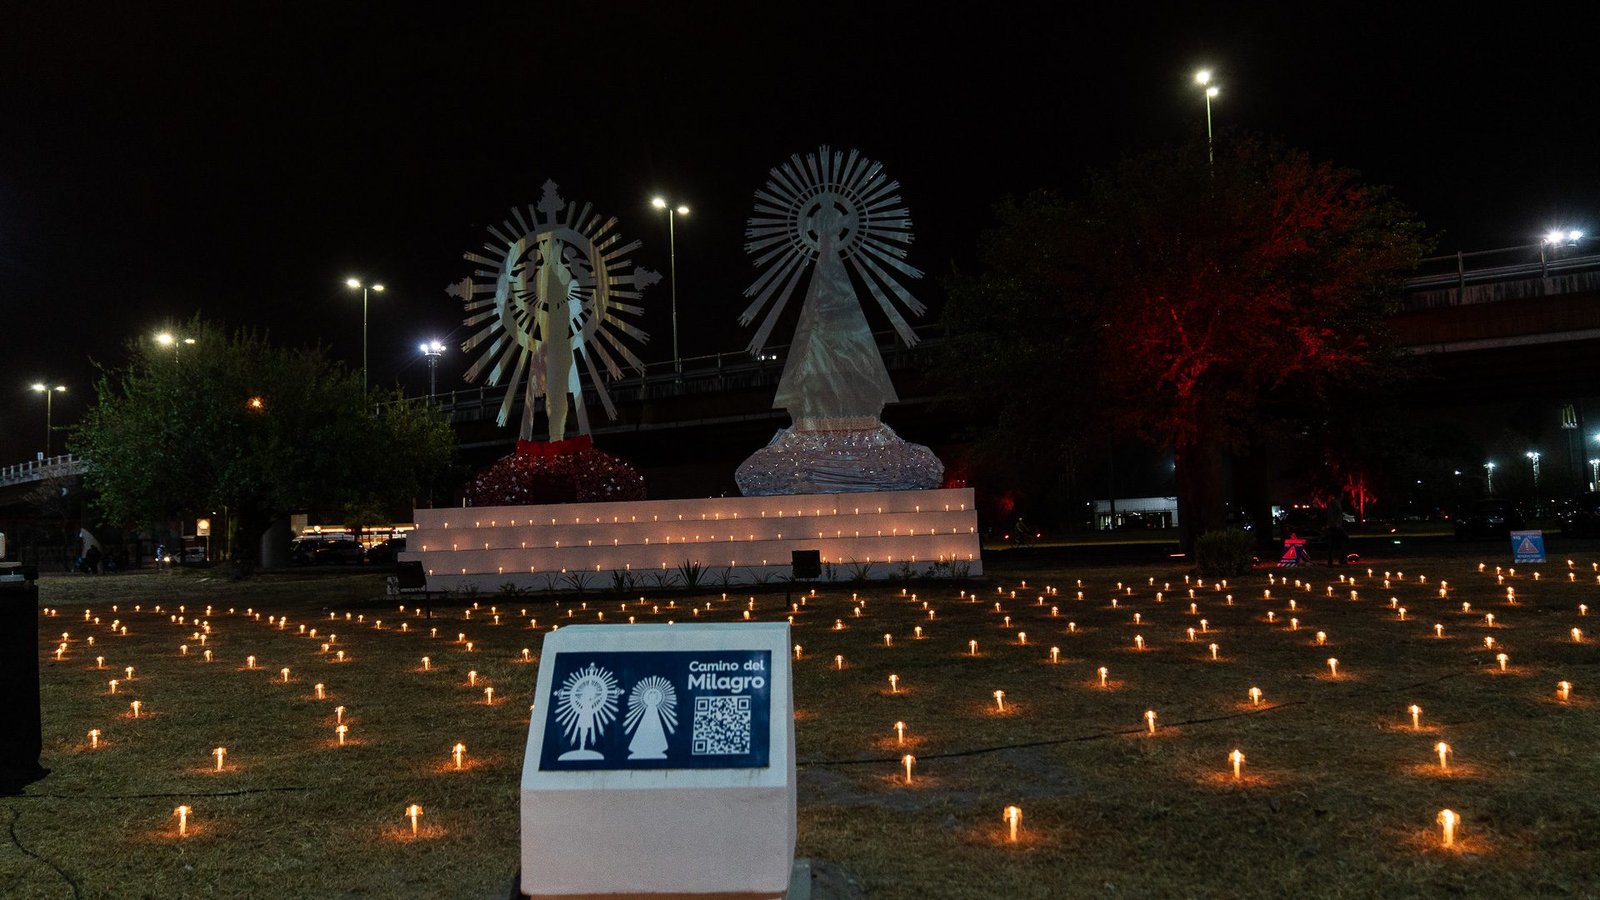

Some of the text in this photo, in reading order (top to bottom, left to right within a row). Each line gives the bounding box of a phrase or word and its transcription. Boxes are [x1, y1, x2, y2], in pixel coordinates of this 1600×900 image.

[689, 660, 764, 672] Camino del
[688, 673, 765, 694] Milagro
